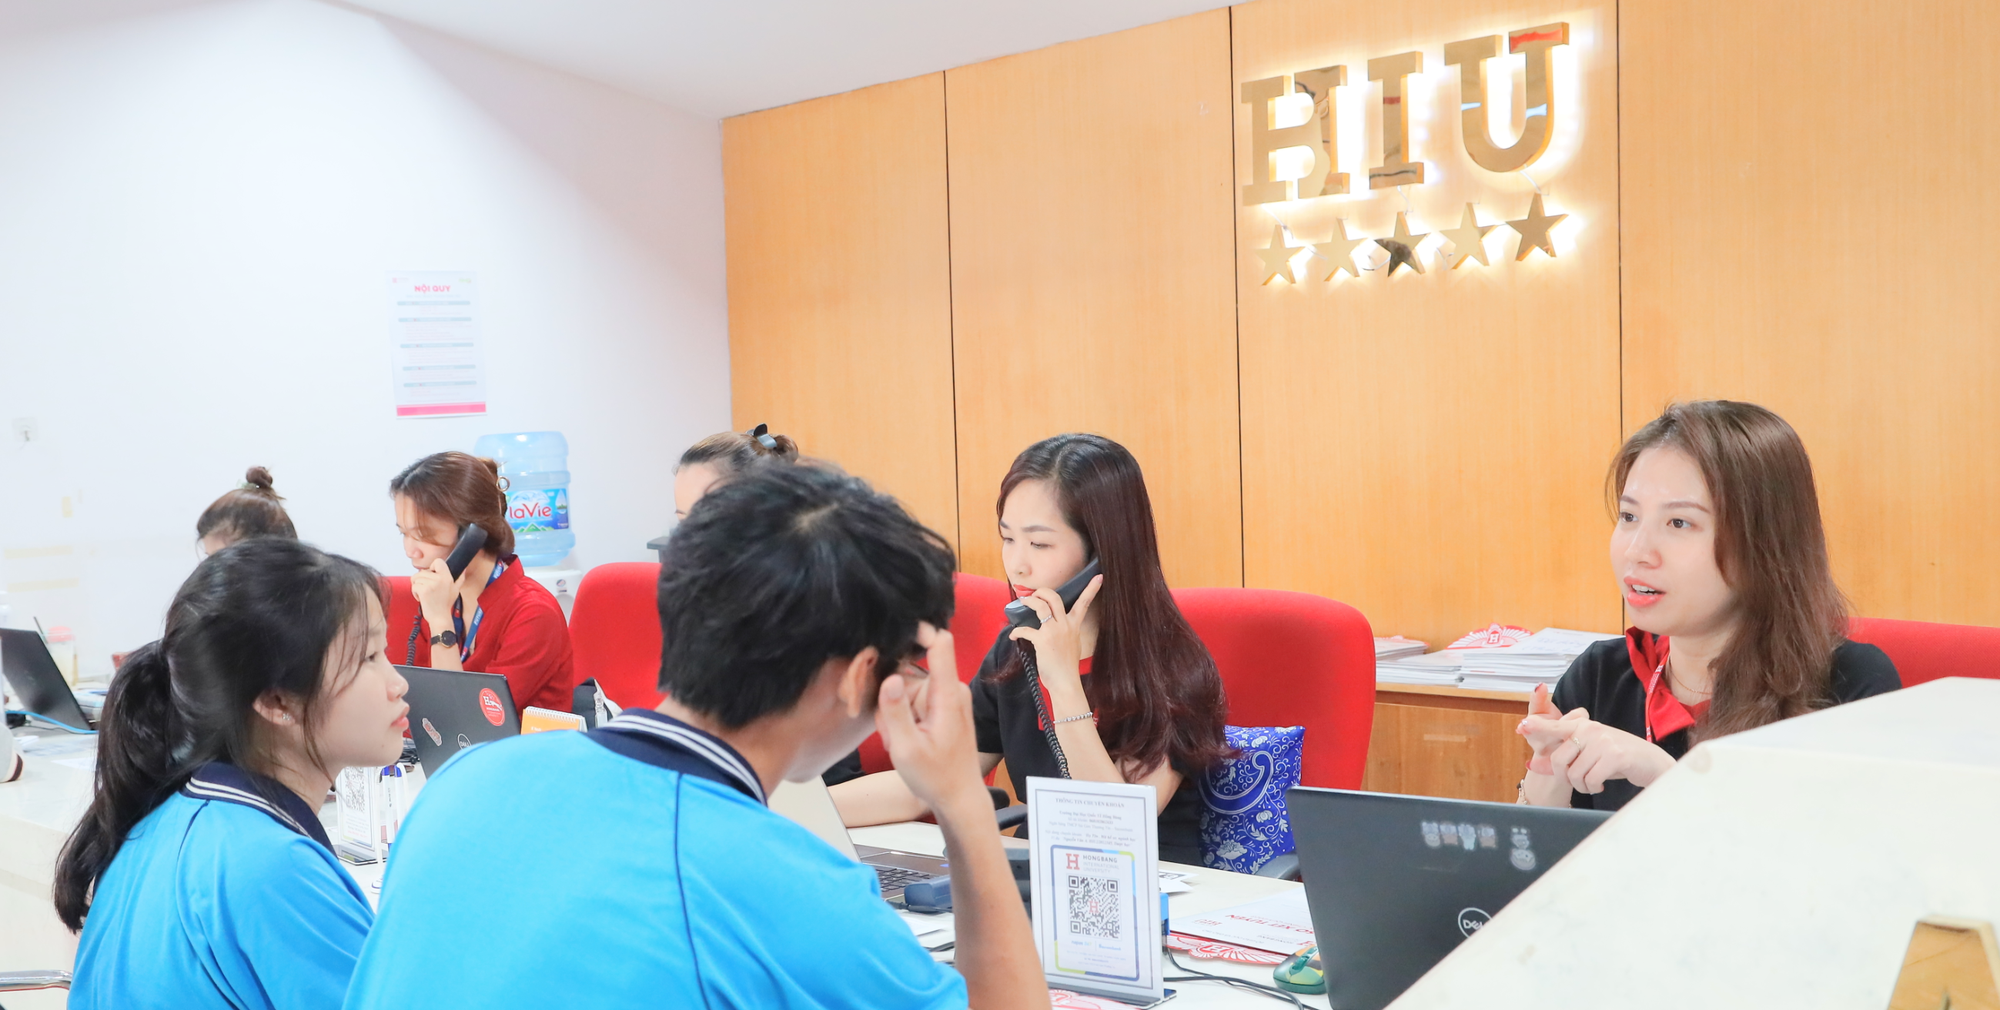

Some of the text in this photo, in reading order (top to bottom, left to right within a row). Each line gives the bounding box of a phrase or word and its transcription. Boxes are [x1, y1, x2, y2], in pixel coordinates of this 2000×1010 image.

[1241, 22, 1569, 205] HIU
[415, 284, 430, 293] NỘI
[509, 502, 552, 519] laVie
[1462, 919, 1484, 930] DEL
